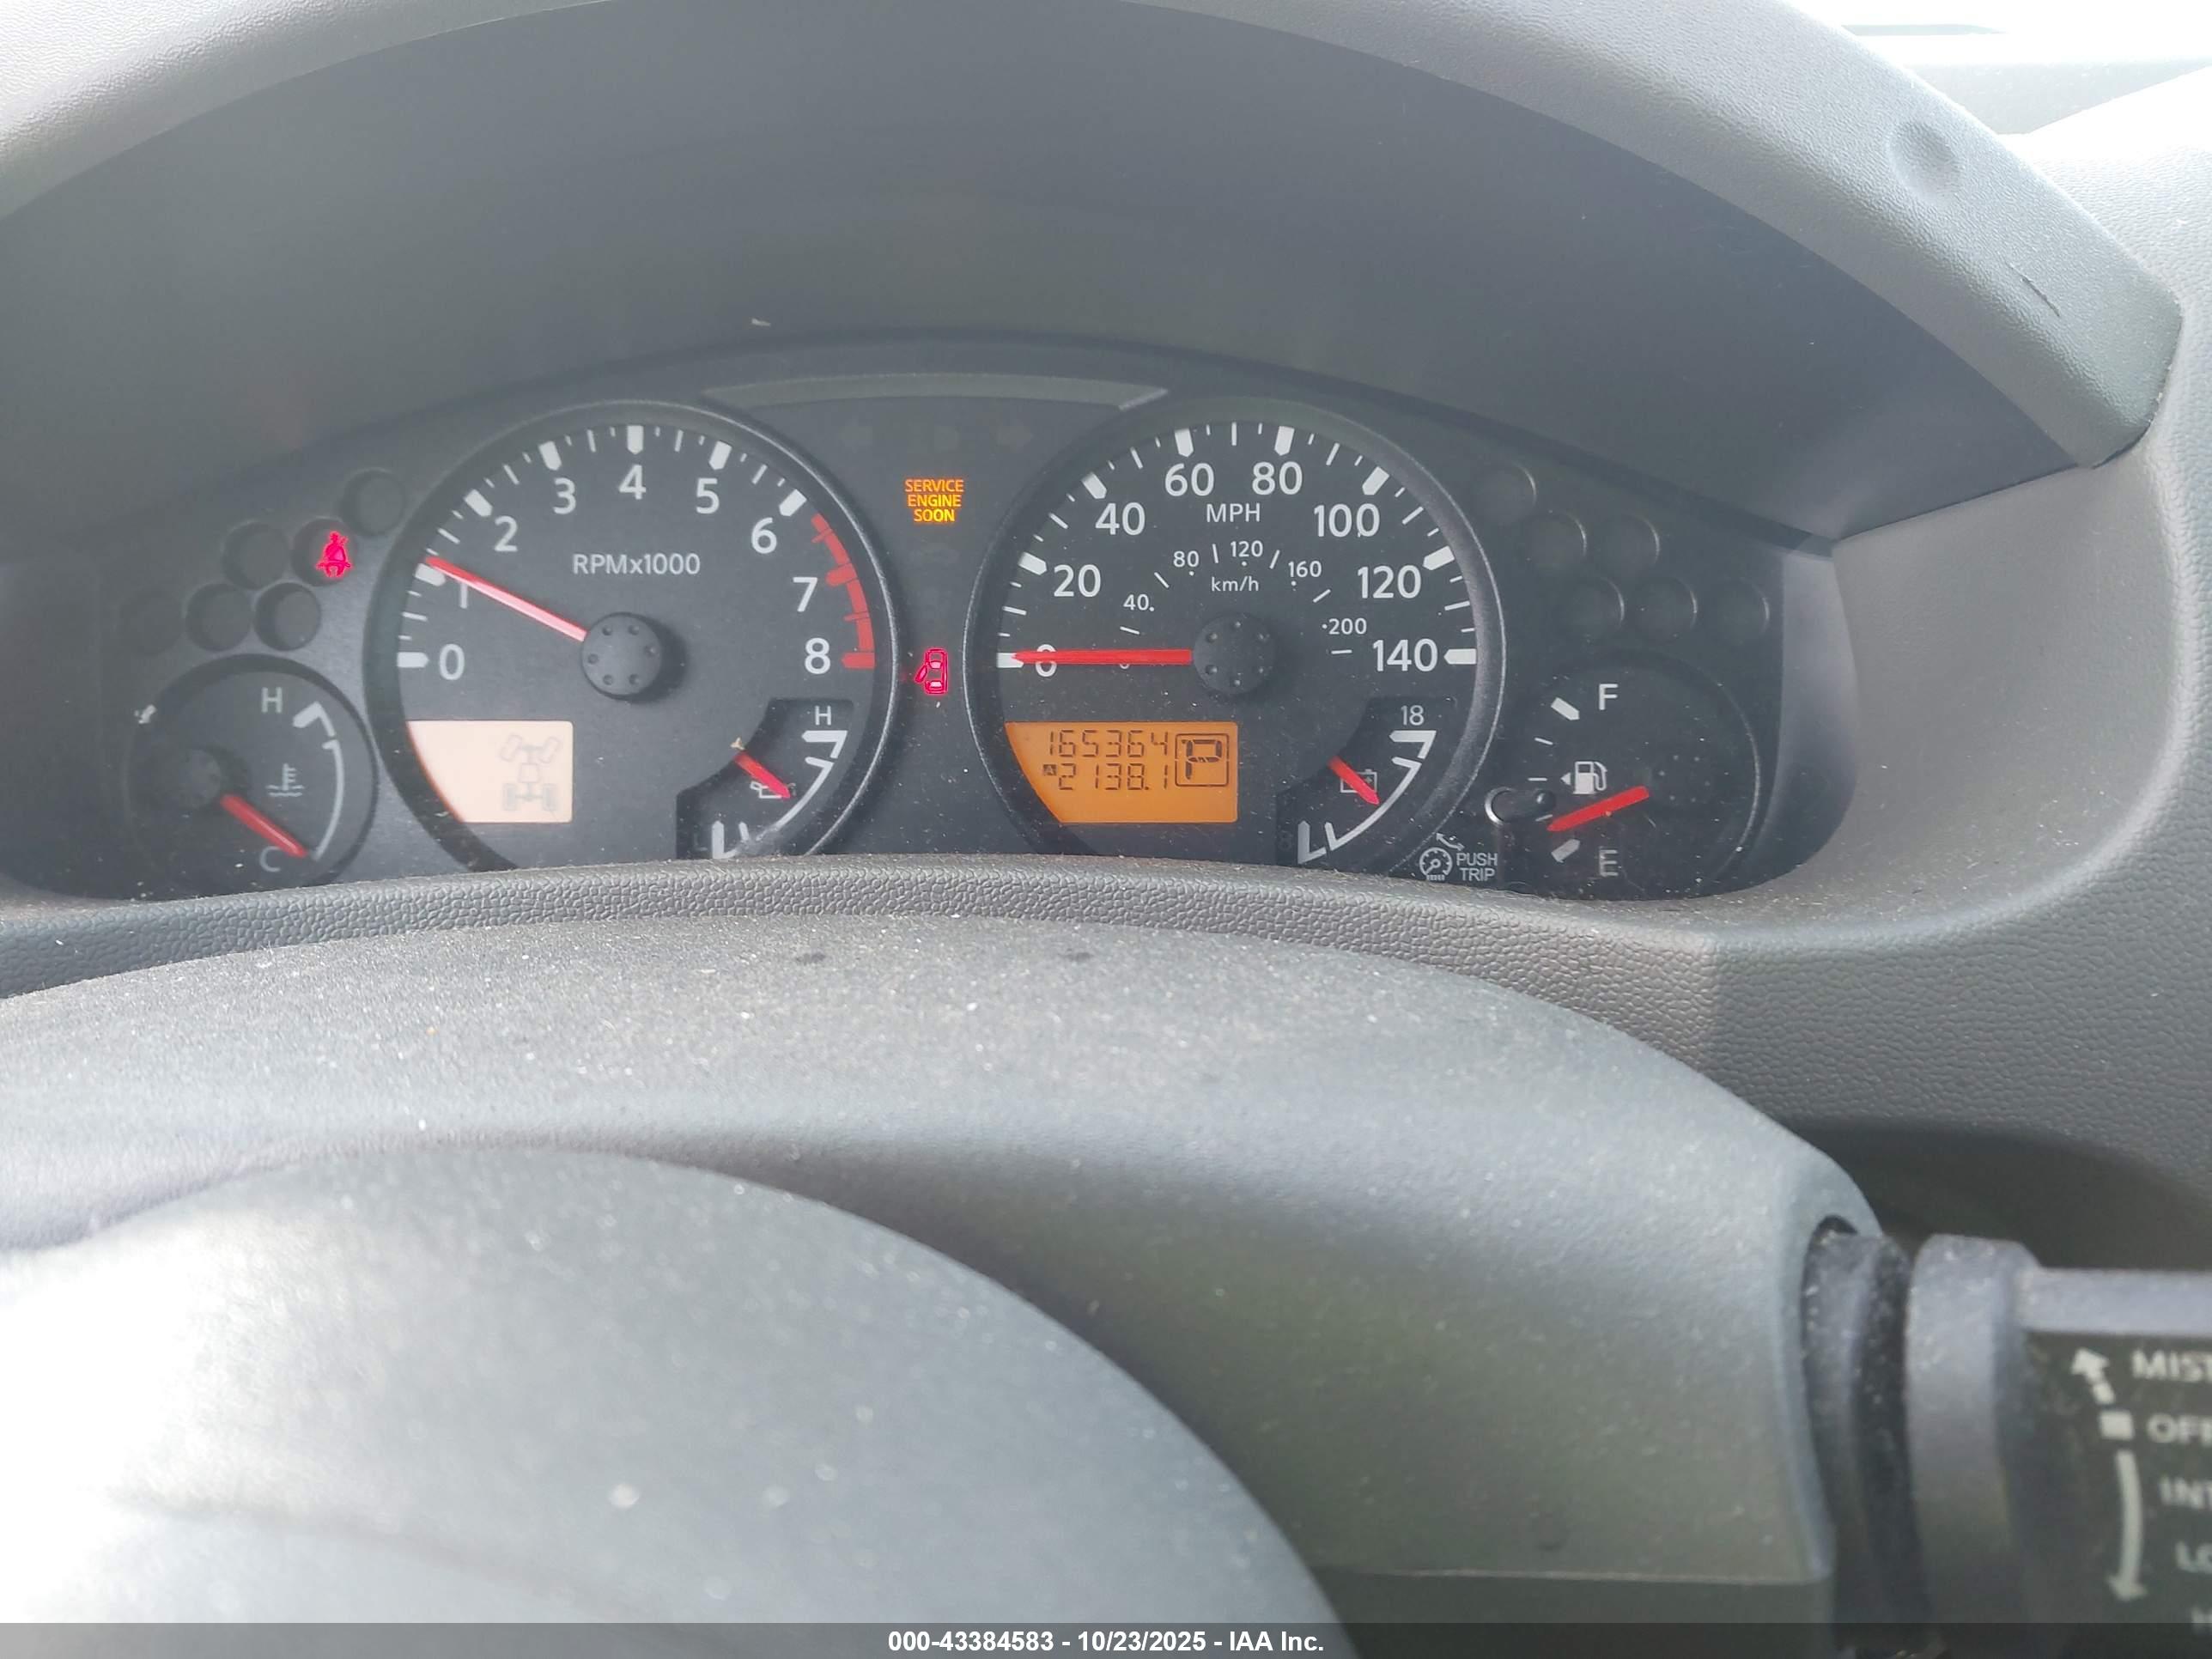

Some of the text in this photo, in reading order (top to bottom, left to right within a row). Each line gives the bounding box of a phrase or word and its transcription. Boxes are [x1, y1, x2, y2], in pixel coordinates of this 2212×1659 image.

[619, 465, 647, 499] 4
[904, 479, 964, 492] SERVICE
[1164, 462, 1214, 496] 60
[1252, 461, 1303, 495] 80
[554, 477, 576, 514] 3
[696, 477, 720, 514] 5
[908, 494, 962, 507] ENGINE
[914, 508, 956, 522] SOON
[1095, 502, 1146, 536] 40
[1206, 503, 1261, 523] MPH
[1314, 503, 1380, 538] 100
[494, 516, 518, 552] 2
[750, 518, 777, 554] 6
[1173, 550, 1200, 568] 80
[1230, 540, 1263, 557] 120
[573, 553, 701, 575] RPMx1000
[1288, 560, 1322, 578] 160
[793, 576, 818, 611] 7
[1054, 564, 1101, 598] 20
[1211, 576, 1259, 592] km/h
[1357, 564, 1421, 599] 120
[1329, 617, 1367, 635] 200
[439, 644, 465, 681] 0
[805, 638, 831, 674] 8
[1372, 639, 1438, 672] 140
[262, 687, 283, 714] H
[1599, 684, 1619, 711] F
[815, 706, 832, 726] H
[1401, 705, 1425, 726] 18
[1050, 729, 1169, 757] 165364
[1182, 738, 1223, 781] P
[1058, 763, 1168, 791] 2138.1
[259, 846, 281, 872] C
[1455, 852, 1498, 866] PUSH
[1599, 849, 1618, 878] E
[1459, 867, 1495, 882] TRIP
